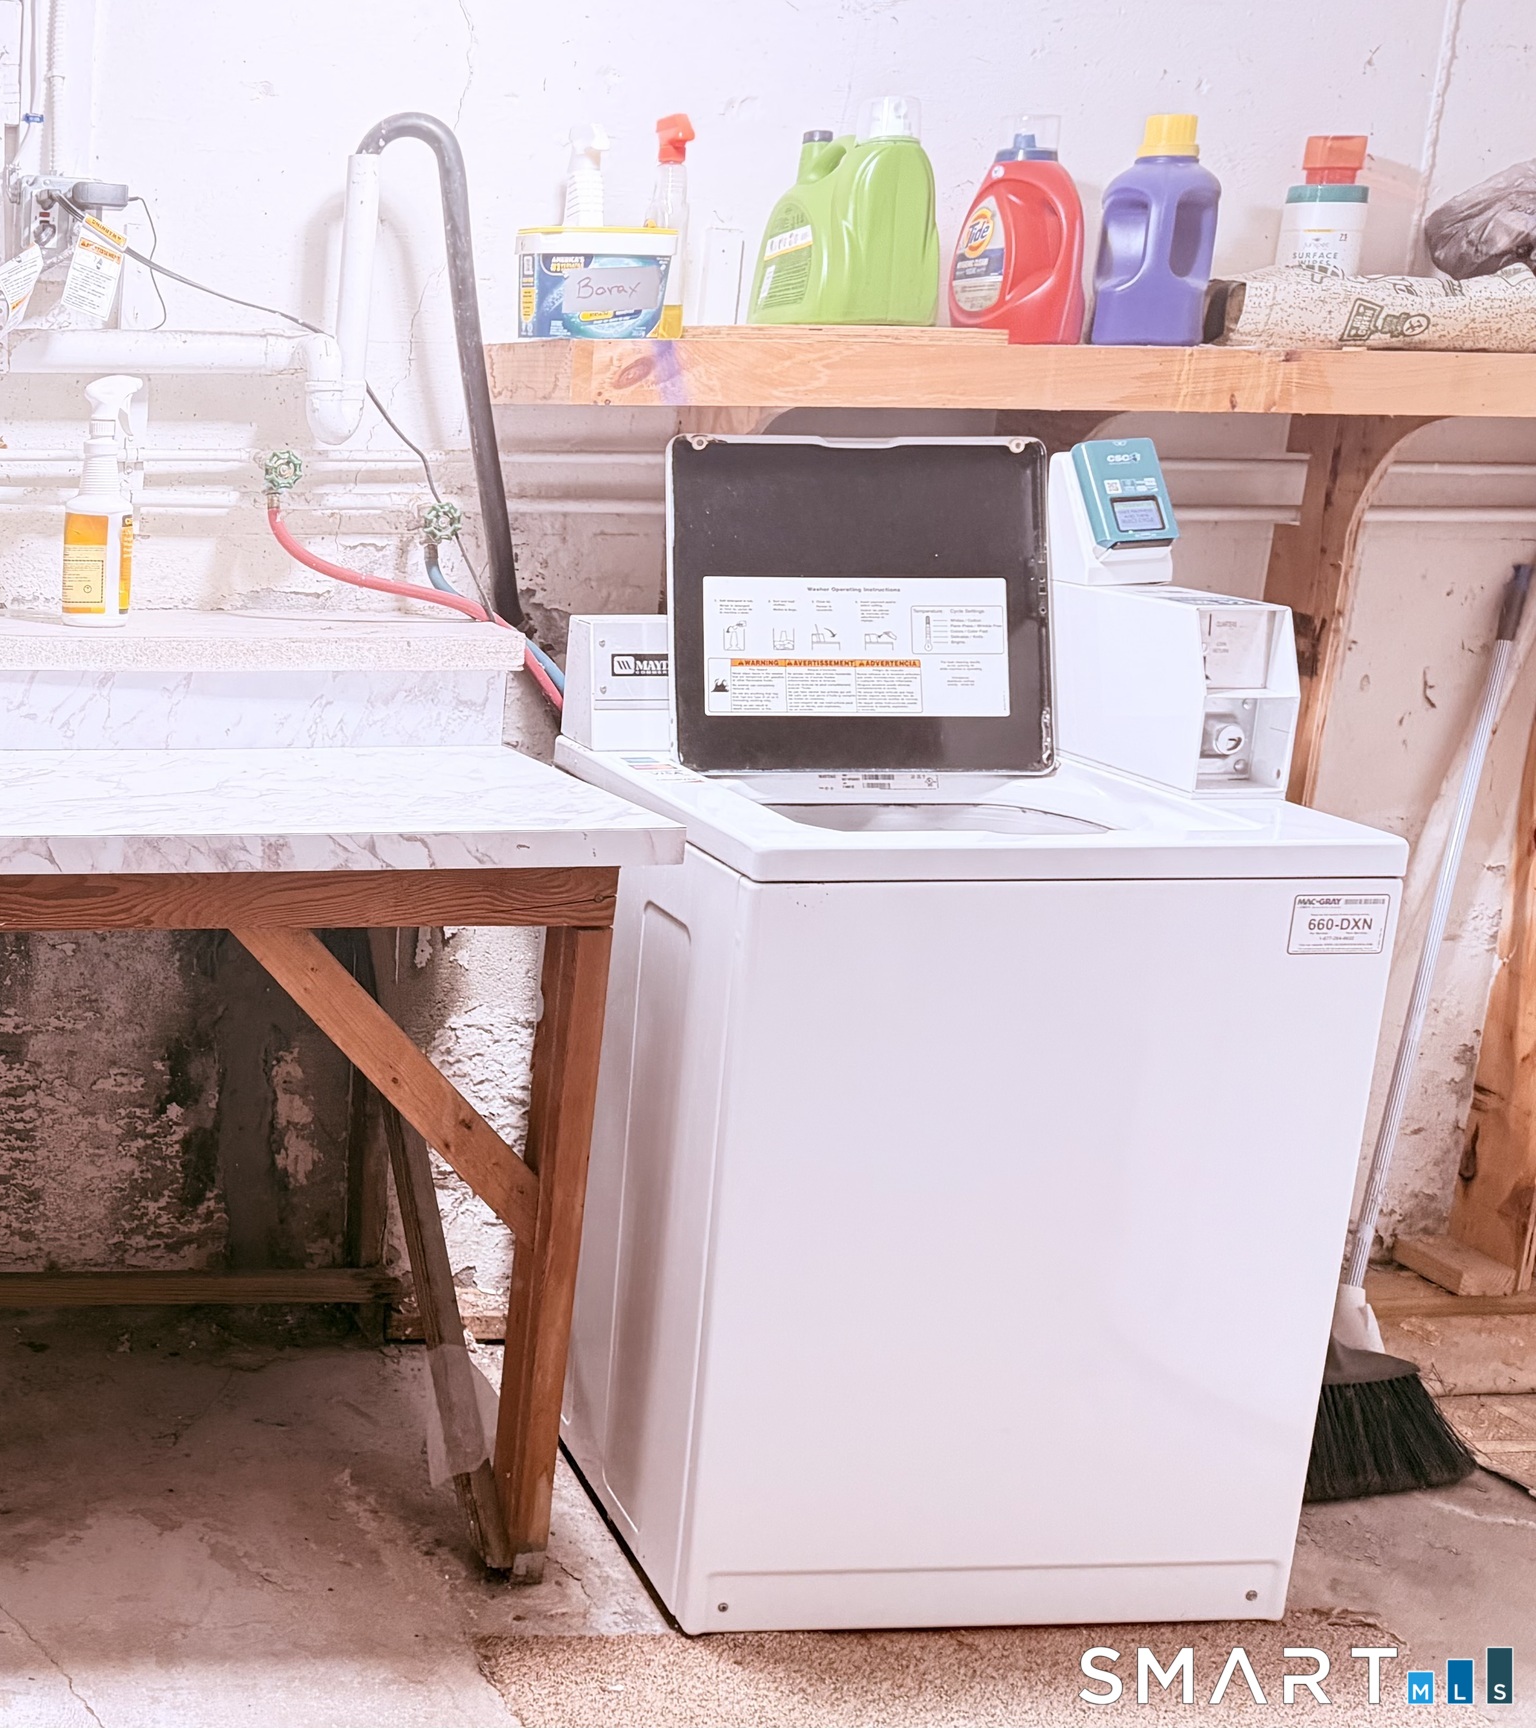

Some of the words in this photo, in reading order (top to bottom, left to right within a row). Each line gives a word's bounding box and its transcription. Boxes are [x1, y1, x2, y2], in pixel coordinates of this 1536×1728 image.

[965, 222, 990, 248] Tide
[576, 276, 641, 299] Borax
[1308, 918, 1373, 930] 660-DXN
